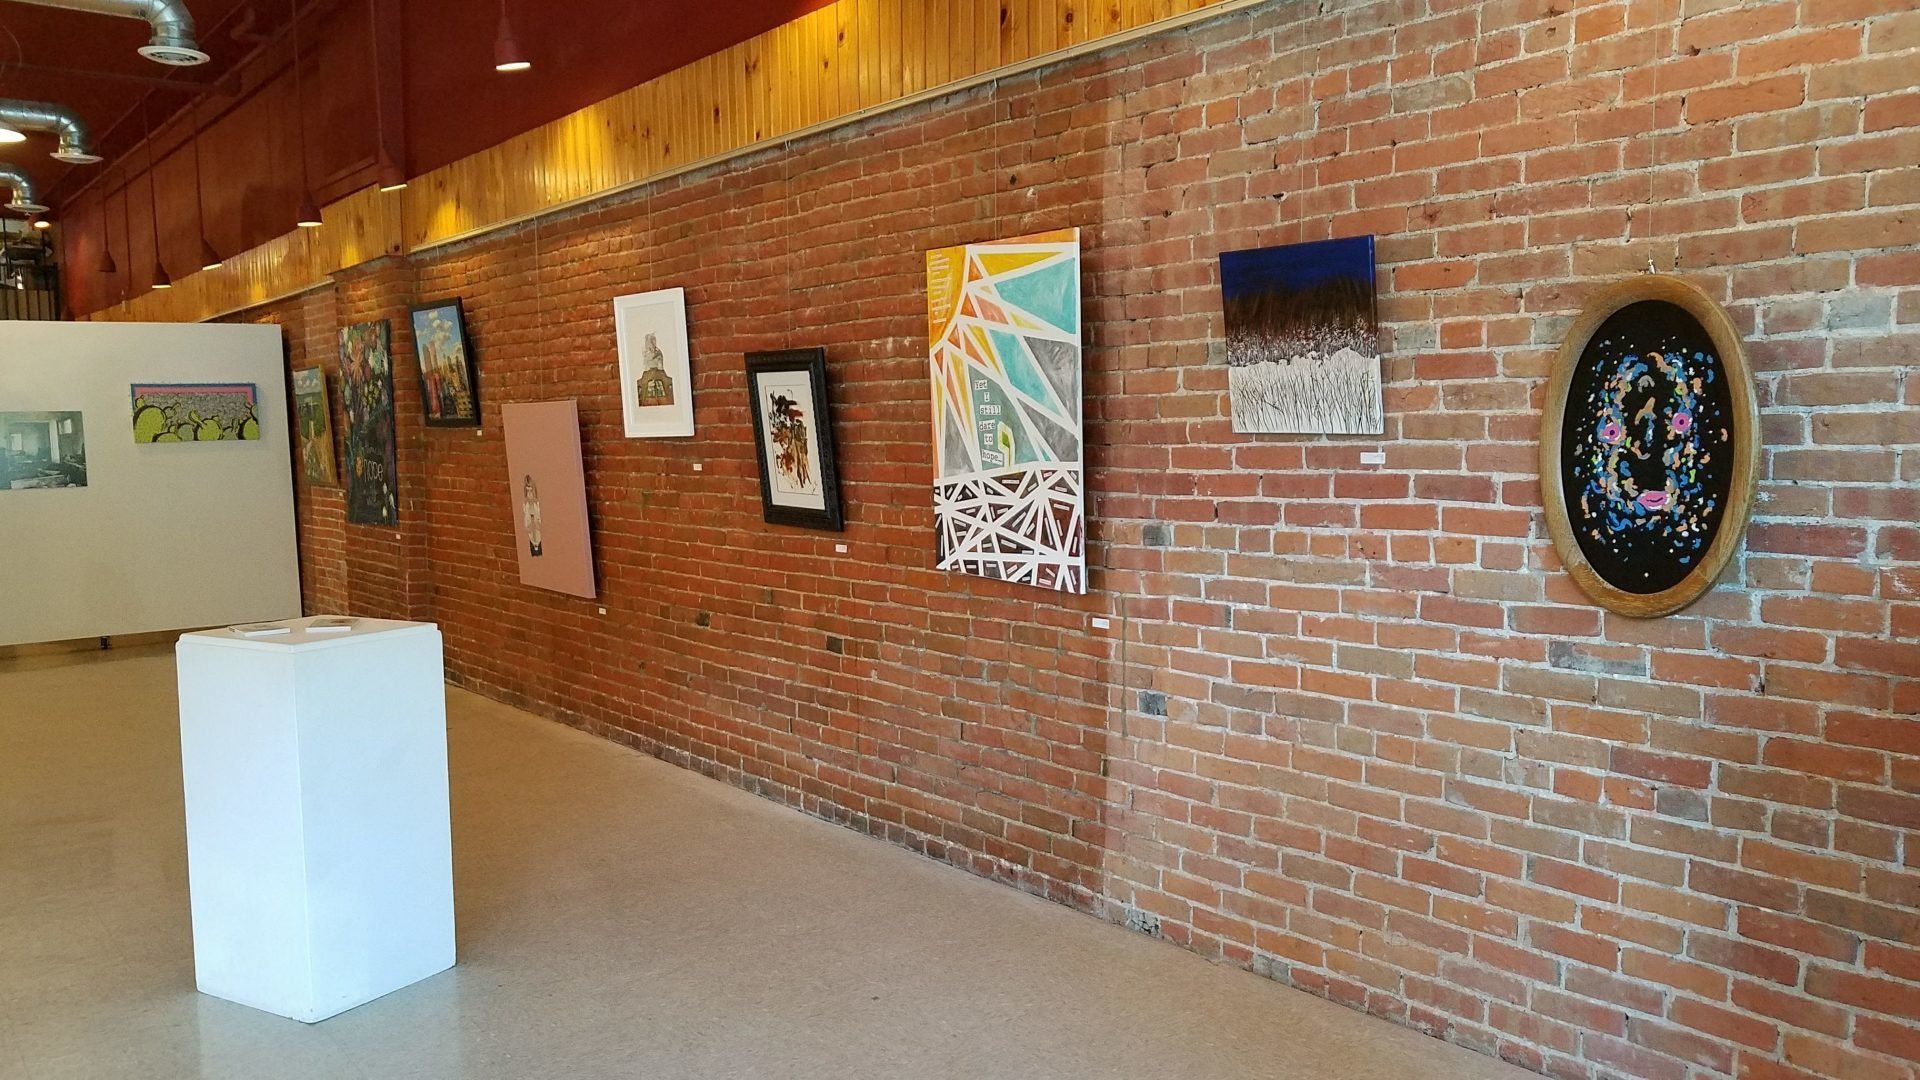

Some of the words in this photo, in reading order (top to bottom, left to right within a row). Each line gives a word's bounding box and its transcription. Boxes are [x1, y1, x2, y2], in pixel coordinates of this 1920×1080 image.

[980, 405, 1001, 415] still
[979, 421, 995, 431] dare
[985, 435, 993, 444] to
